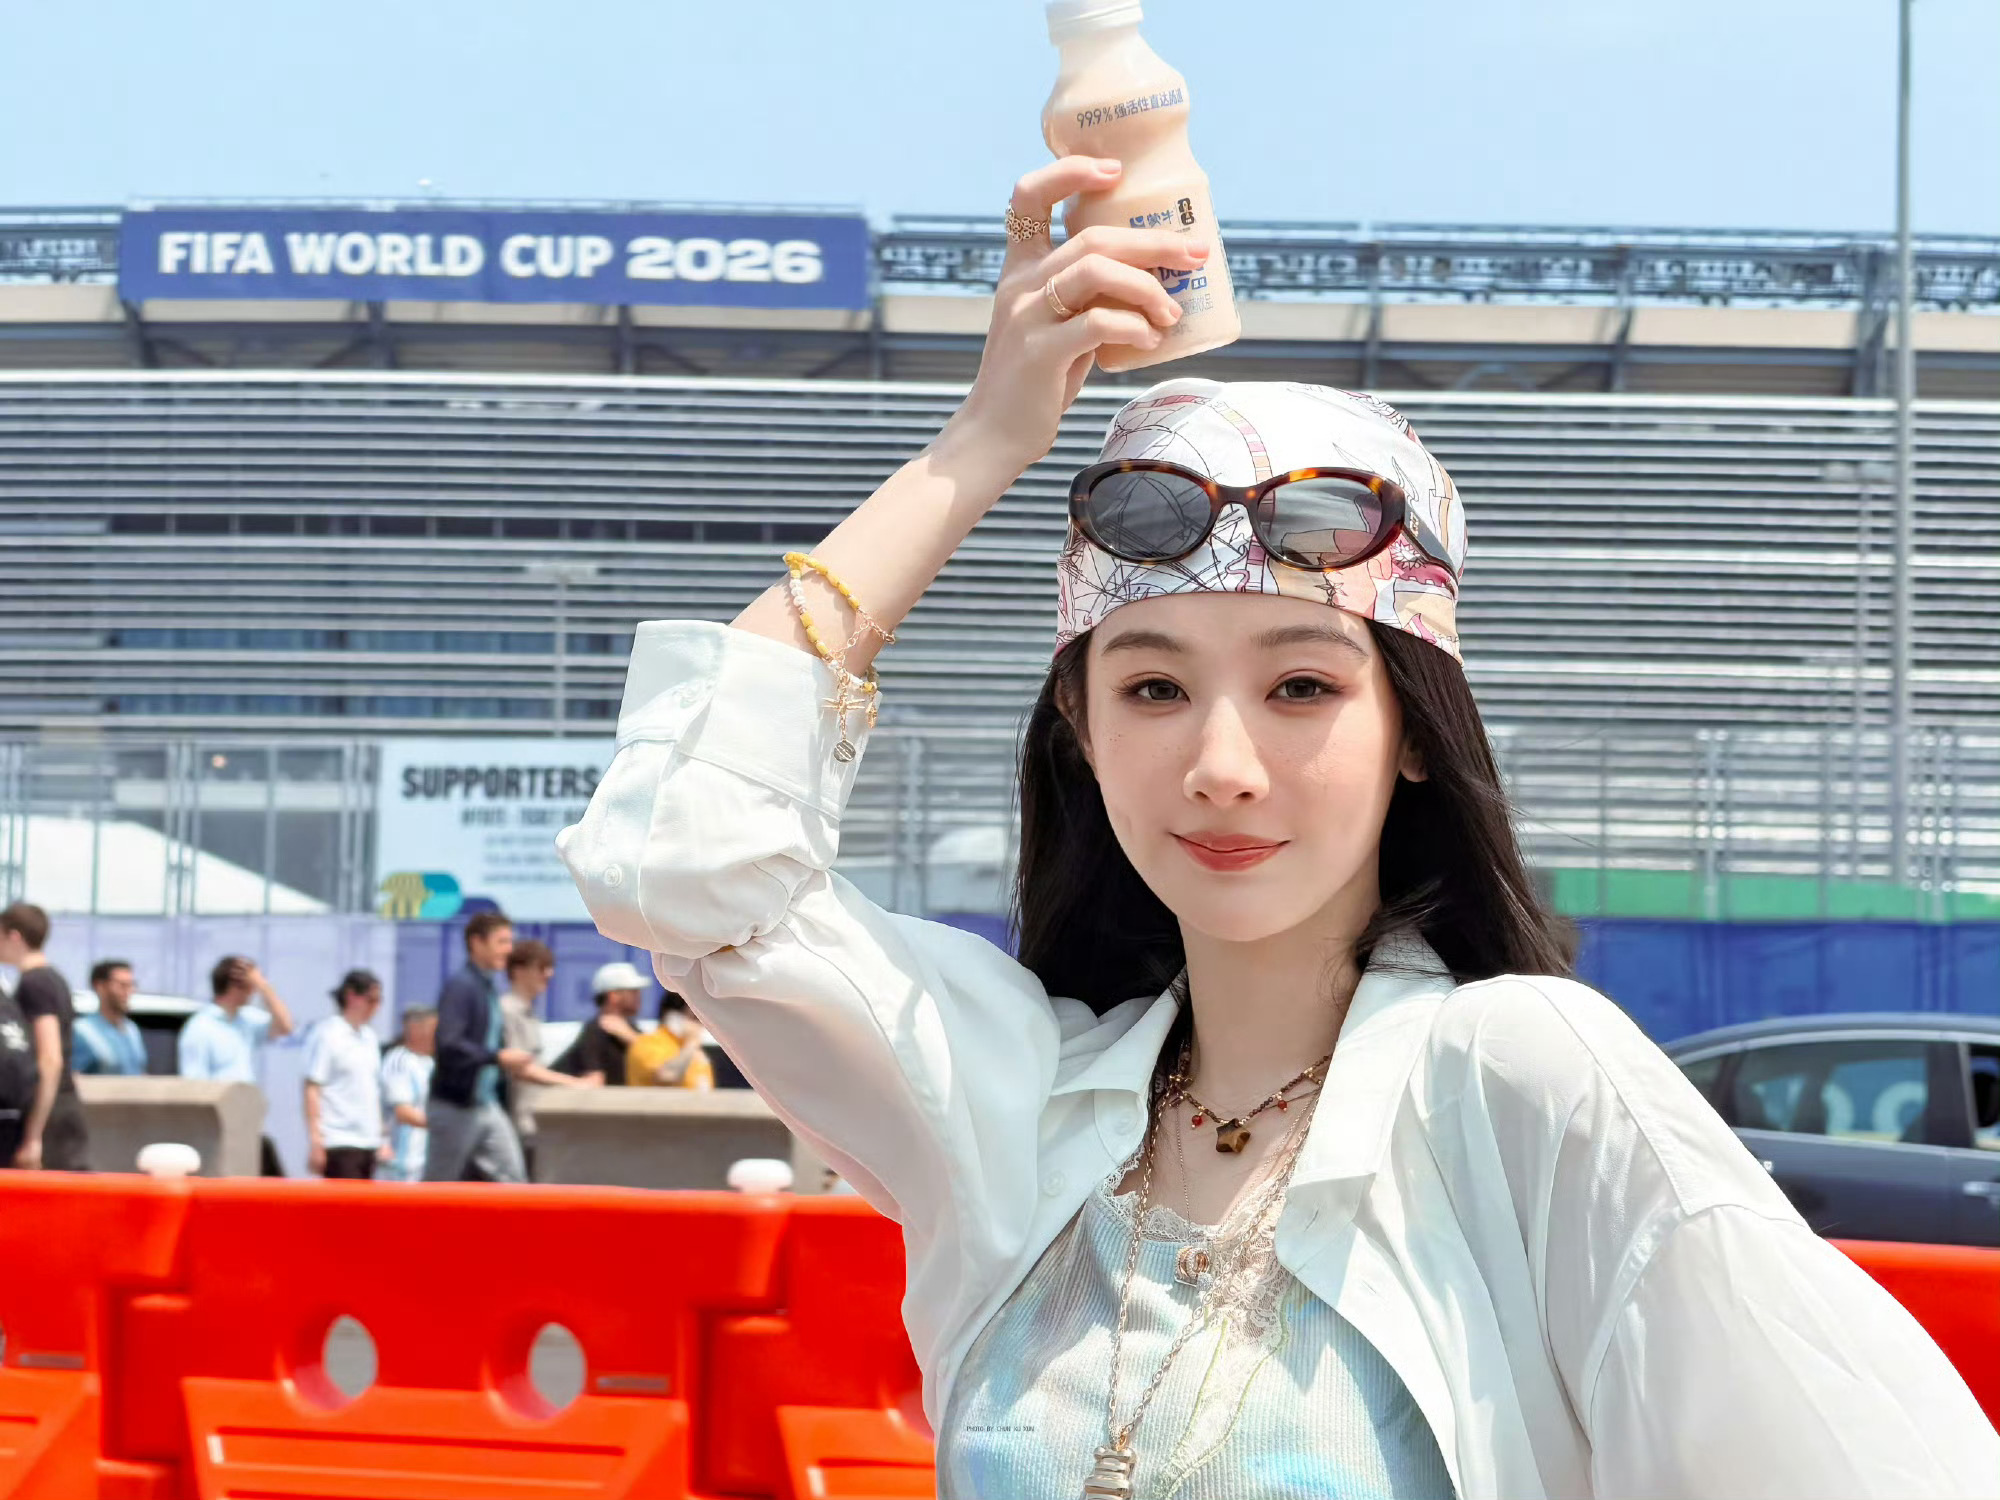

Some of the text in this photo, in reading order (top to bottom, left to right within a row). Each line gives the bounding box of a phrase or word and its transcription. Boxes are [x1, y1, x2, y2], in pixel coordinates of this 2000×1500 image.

[1076, 106, 1113, 128] 99.9%
[159, 231, 823, 285] FIFA WORLD CUP 2026
[402, 766, 599, 800] SUPPORTERS
